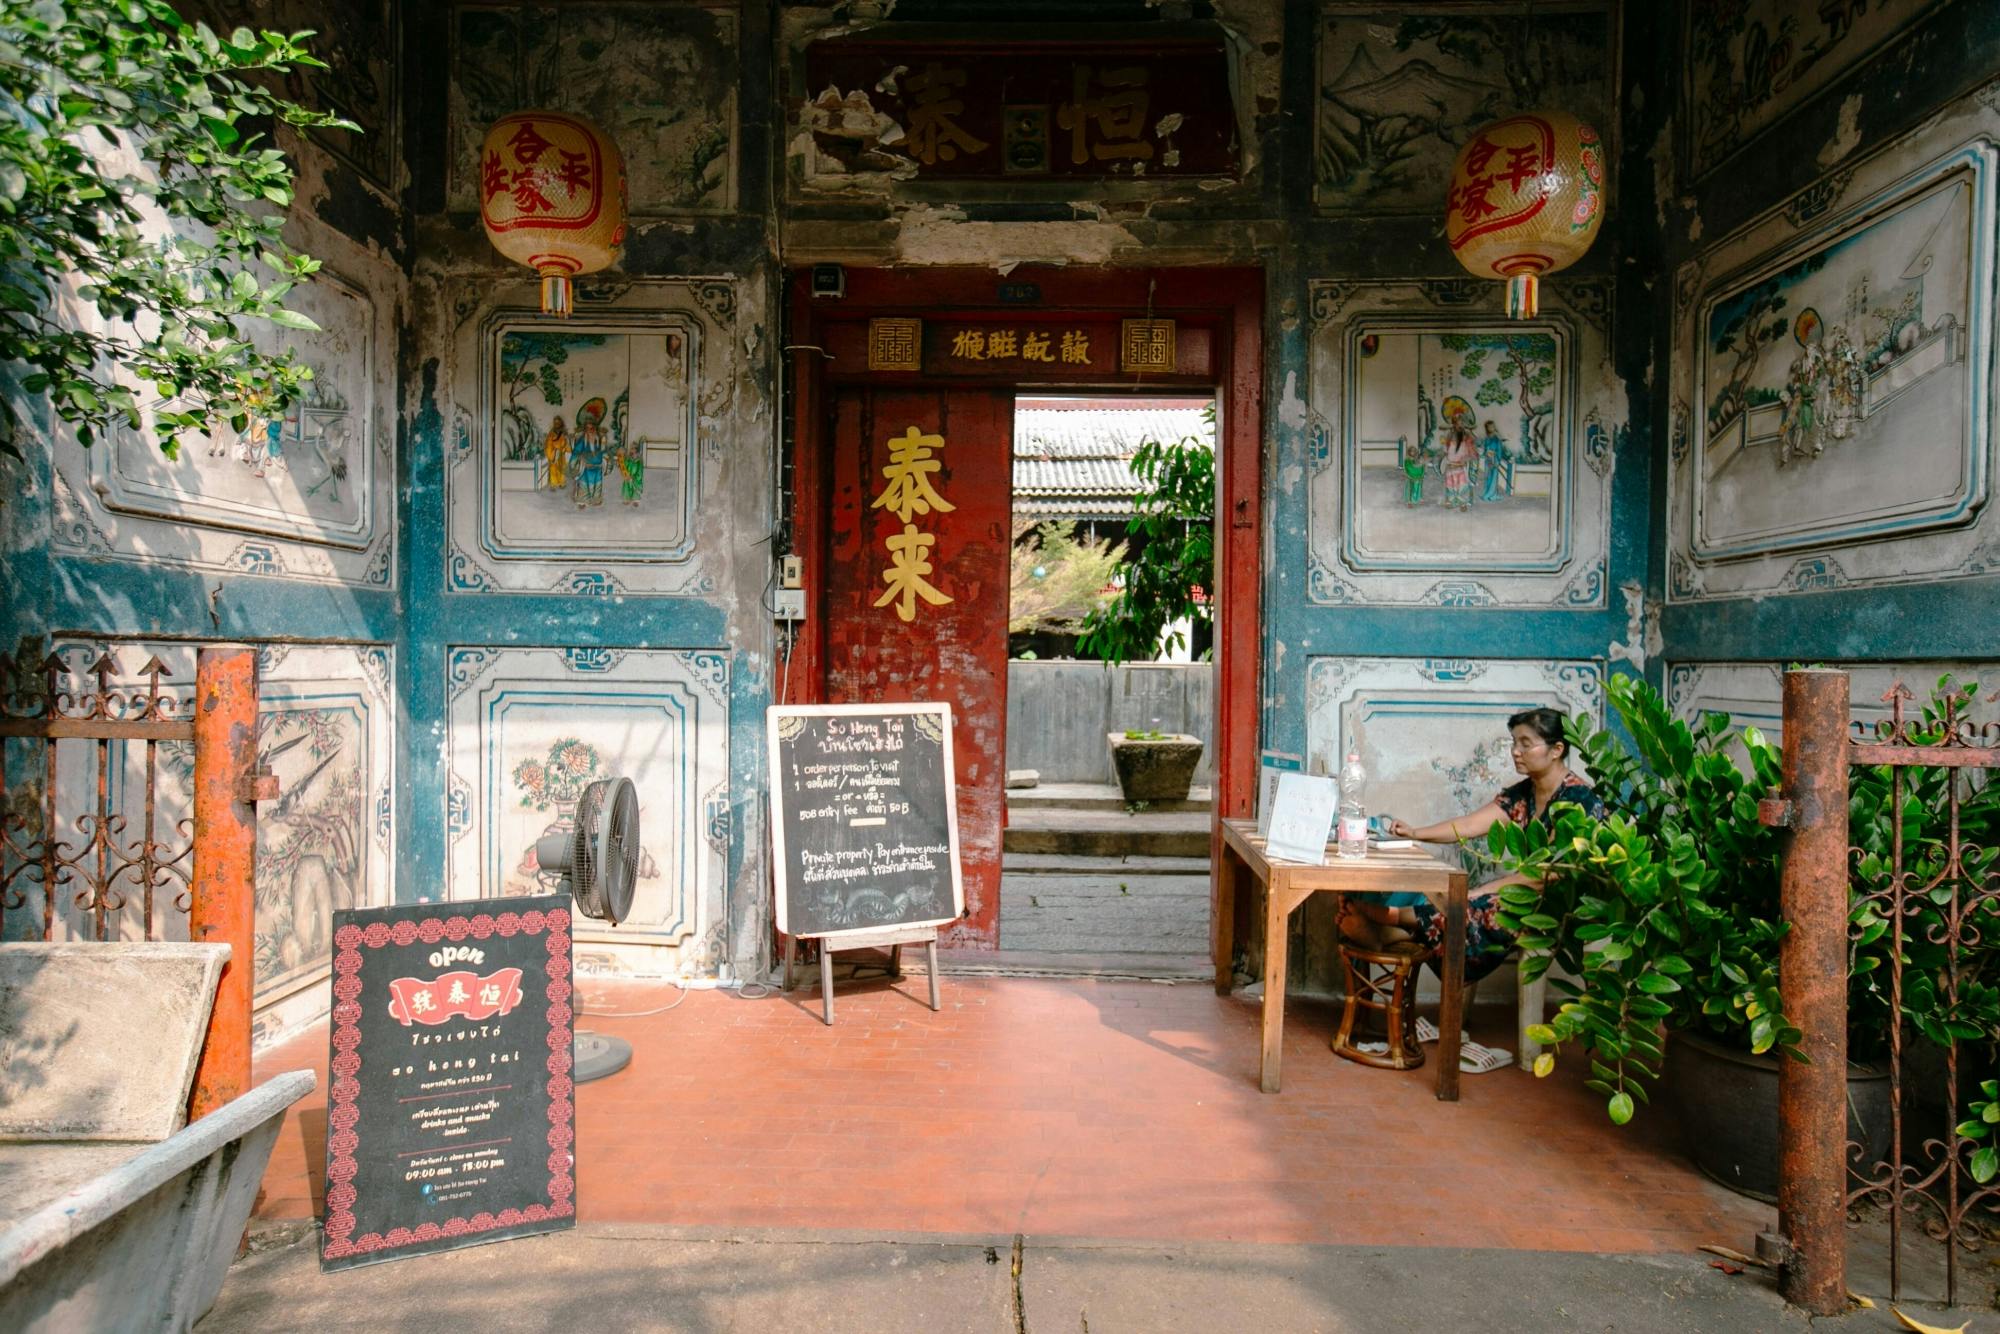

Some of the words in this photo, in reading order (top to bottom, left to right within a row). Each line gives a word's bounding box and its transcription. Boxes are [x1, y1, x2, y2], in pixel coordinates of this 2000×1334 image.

[827, 719, 845, 734] So
[850, 721, 879, 738] Heng
[804, 764, 828, 774] order
[828, 763, 842, 776] per
[842, 763, 869, 776] person
[818, 805, 840, 824] entry
[801, 849, 834, 865] Private
[428, 945, 486, 968] open
[421, 1118, 446, 1130] drinks
[447, 1115, 463, 1126] and
[465, 1112, 491, 1124] snacks
[405, 1168, 436, 1181] 09:00
[437, 1166, 452, 1176] am
[490, 1158, 505, 1169] pm
